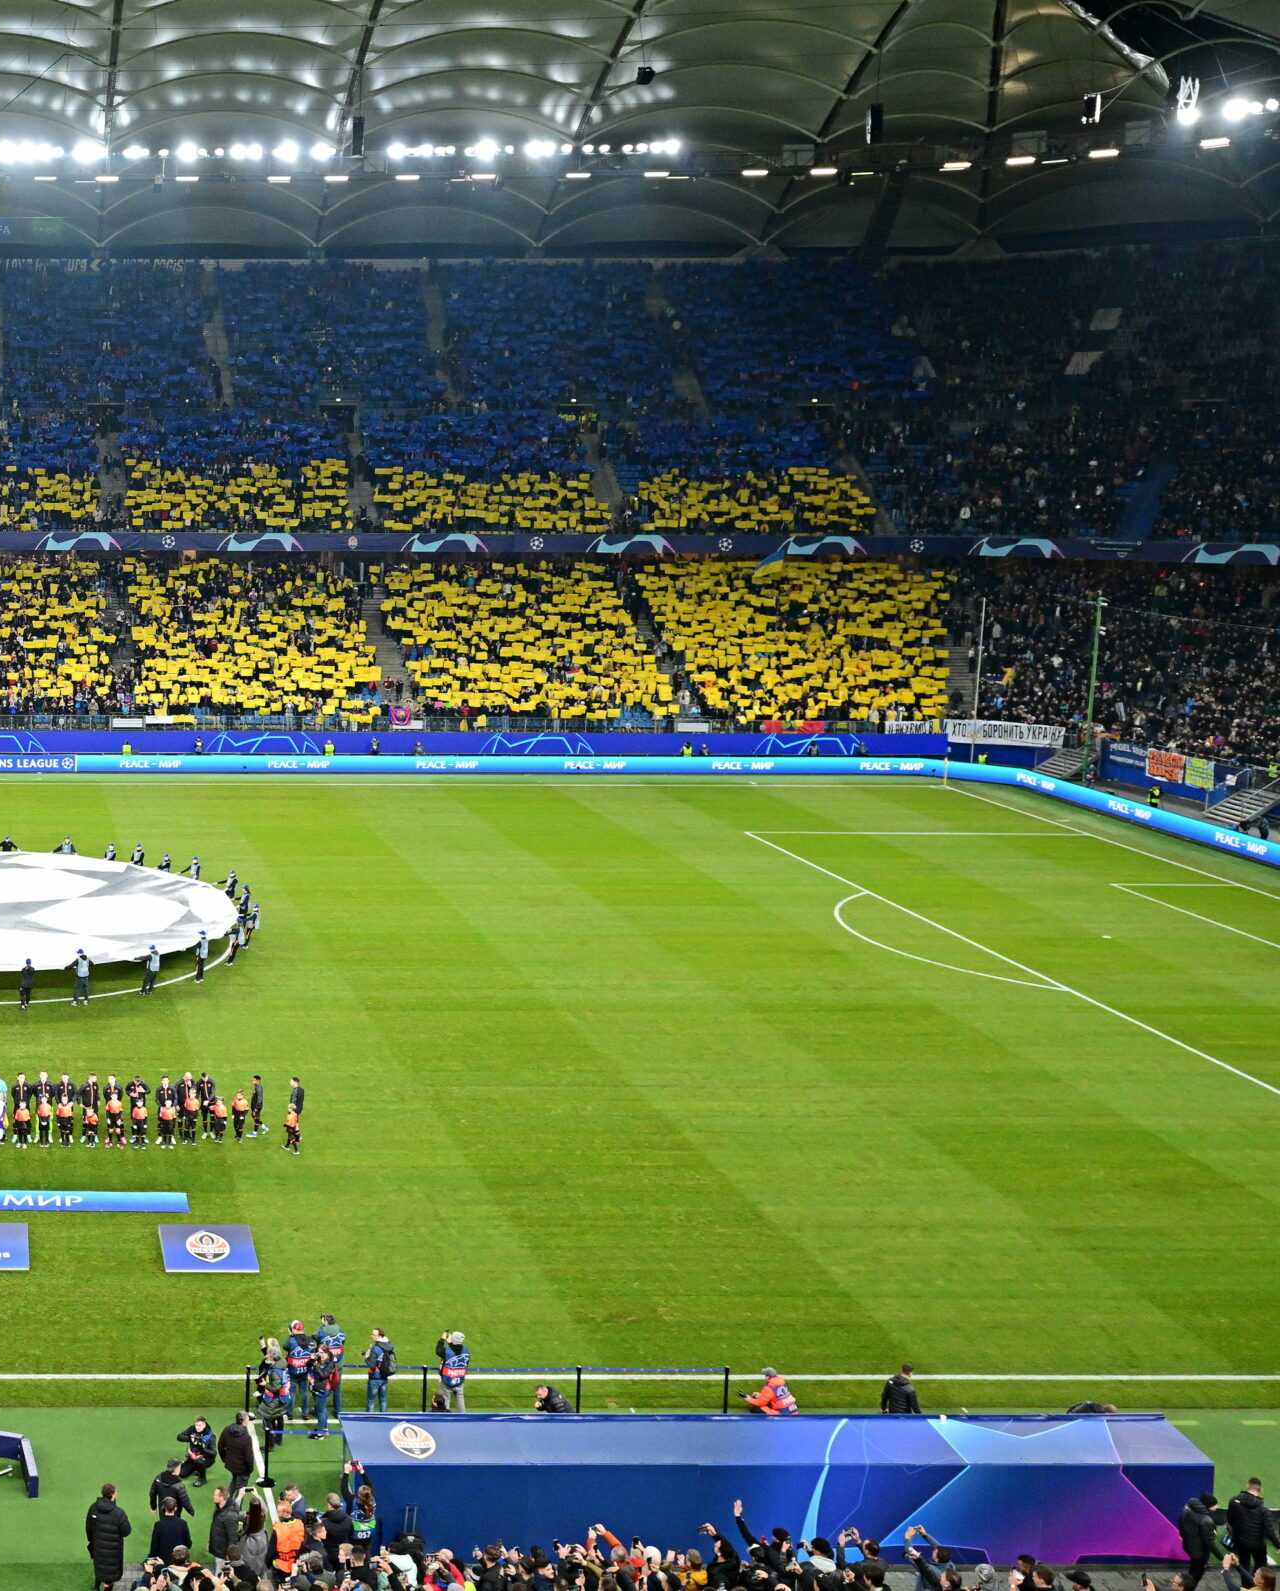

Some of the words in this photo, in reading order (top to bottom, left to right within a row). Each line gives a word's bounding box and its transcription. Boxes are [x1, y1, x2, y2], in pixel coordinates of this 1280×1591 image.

[951, 723, 967, 737] ХТО
[982, 724, 1023, 739] БОРОНИТЬ
[1025, 726, 1064, 741] УКРАЇНУ
[17, 758, 59, 769] LEAGUE
[120, 760, 149, 769] PEACE
[268, 760, 297, 769] PEACE
[416, 760, 446, 769] PEACE
[565, 761, 594, 770] PEACE
[712, 761, 741, 770] PEACE
[860, 762, 890, 771] PEACE
[1016, 773, 1036, 785] PEACE
[1108, 800, 1129, 814] PEACE
[1215, 831, 1240, 848] PEACE
[3, 1194, 84, 1207] МИР
[447, 1368, 466, 1376] PHOTO
[357, 1531, 371, 1539] 057
